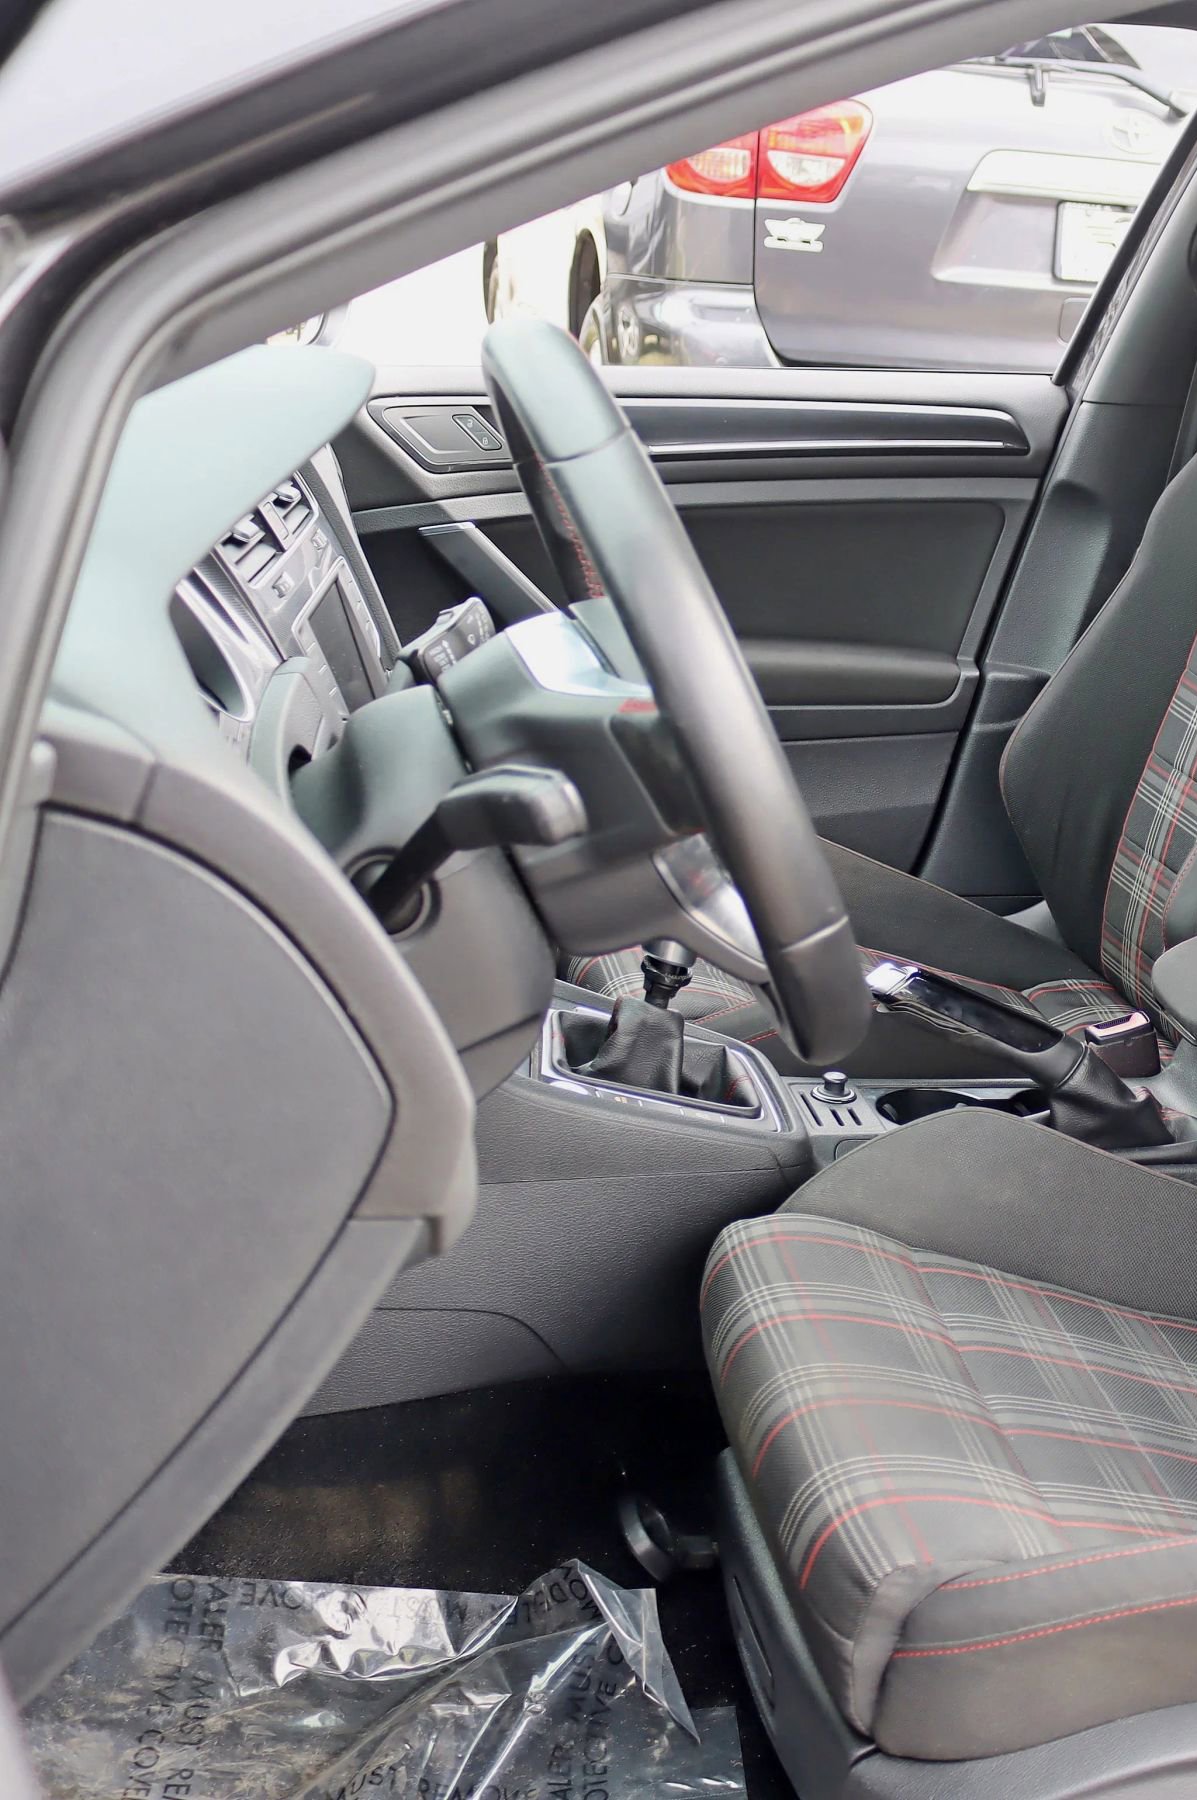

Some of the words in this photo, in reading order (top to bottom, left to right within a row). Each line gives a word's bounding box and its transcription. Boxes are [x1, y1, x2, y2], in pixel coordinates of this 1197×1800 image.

[147, 1577, 194, 1716] OTECTIVE
[200, 1582, 230, 1652] ALER
[174, 1676, 214, 1747] MUST
[547, 1743, 573, 1800] ALER
[567, 1641, 598, 1722] MUST
[582, 1682, 616, 1800] OTECTIVE
[122, 1729, 165, 1800] COVE
